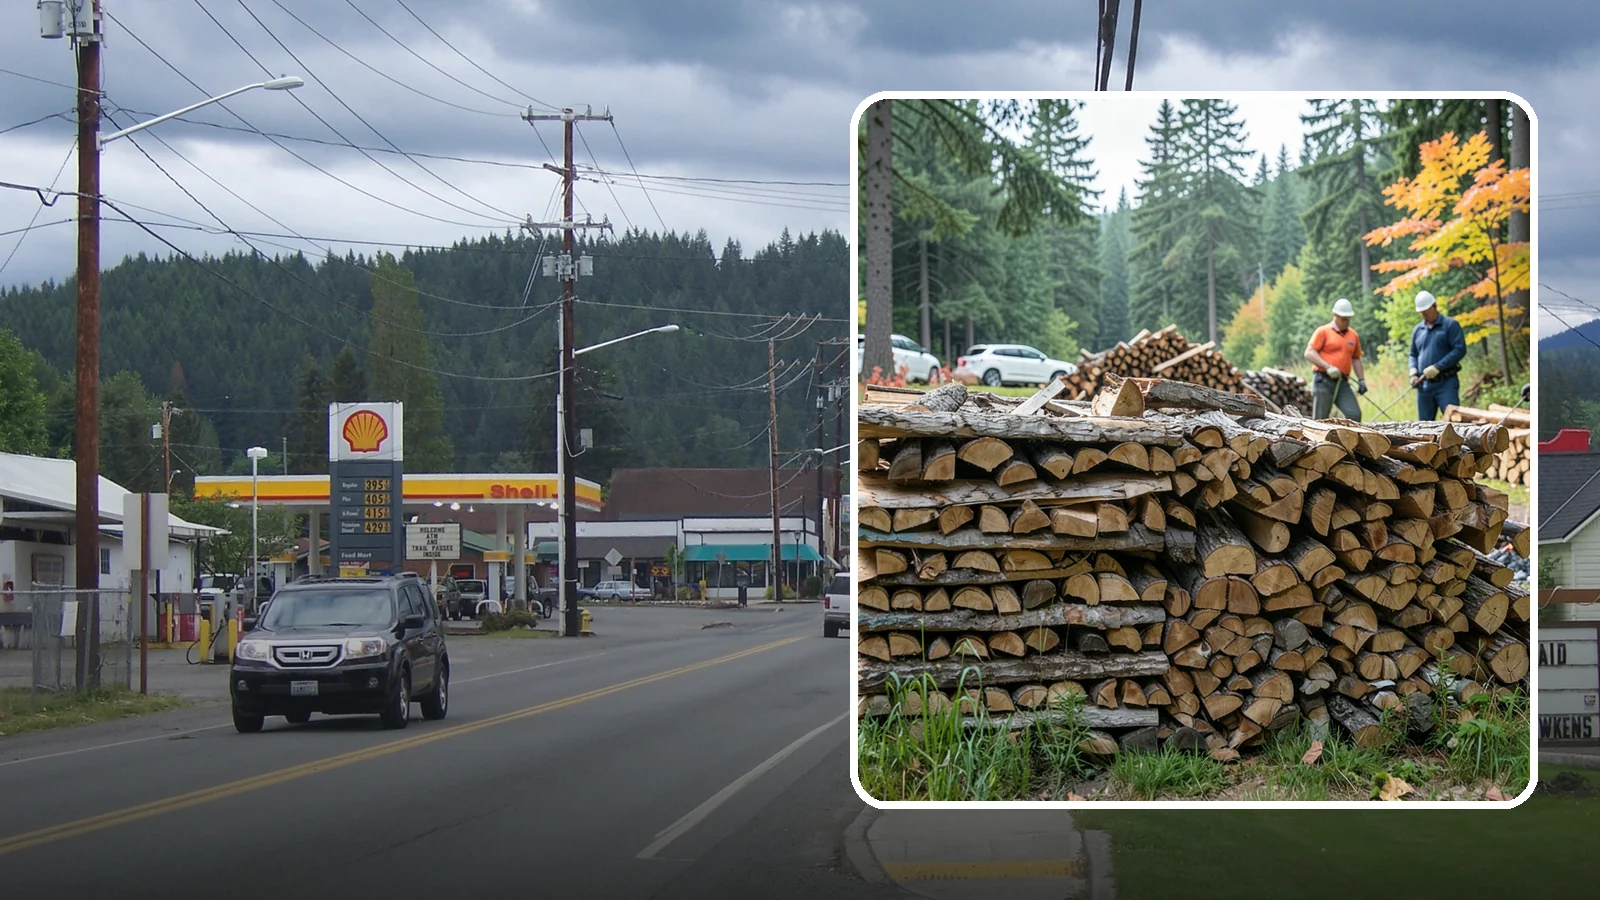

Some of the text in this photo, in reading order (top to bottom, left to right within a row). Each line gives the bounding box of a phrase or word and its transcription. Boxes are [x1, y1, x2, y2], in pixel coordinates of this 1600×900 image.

[490, 484, 547, 499] Shell
[1538, 643, 1567, 666] AID
[1538, 716, 1592, 739] WKENS
